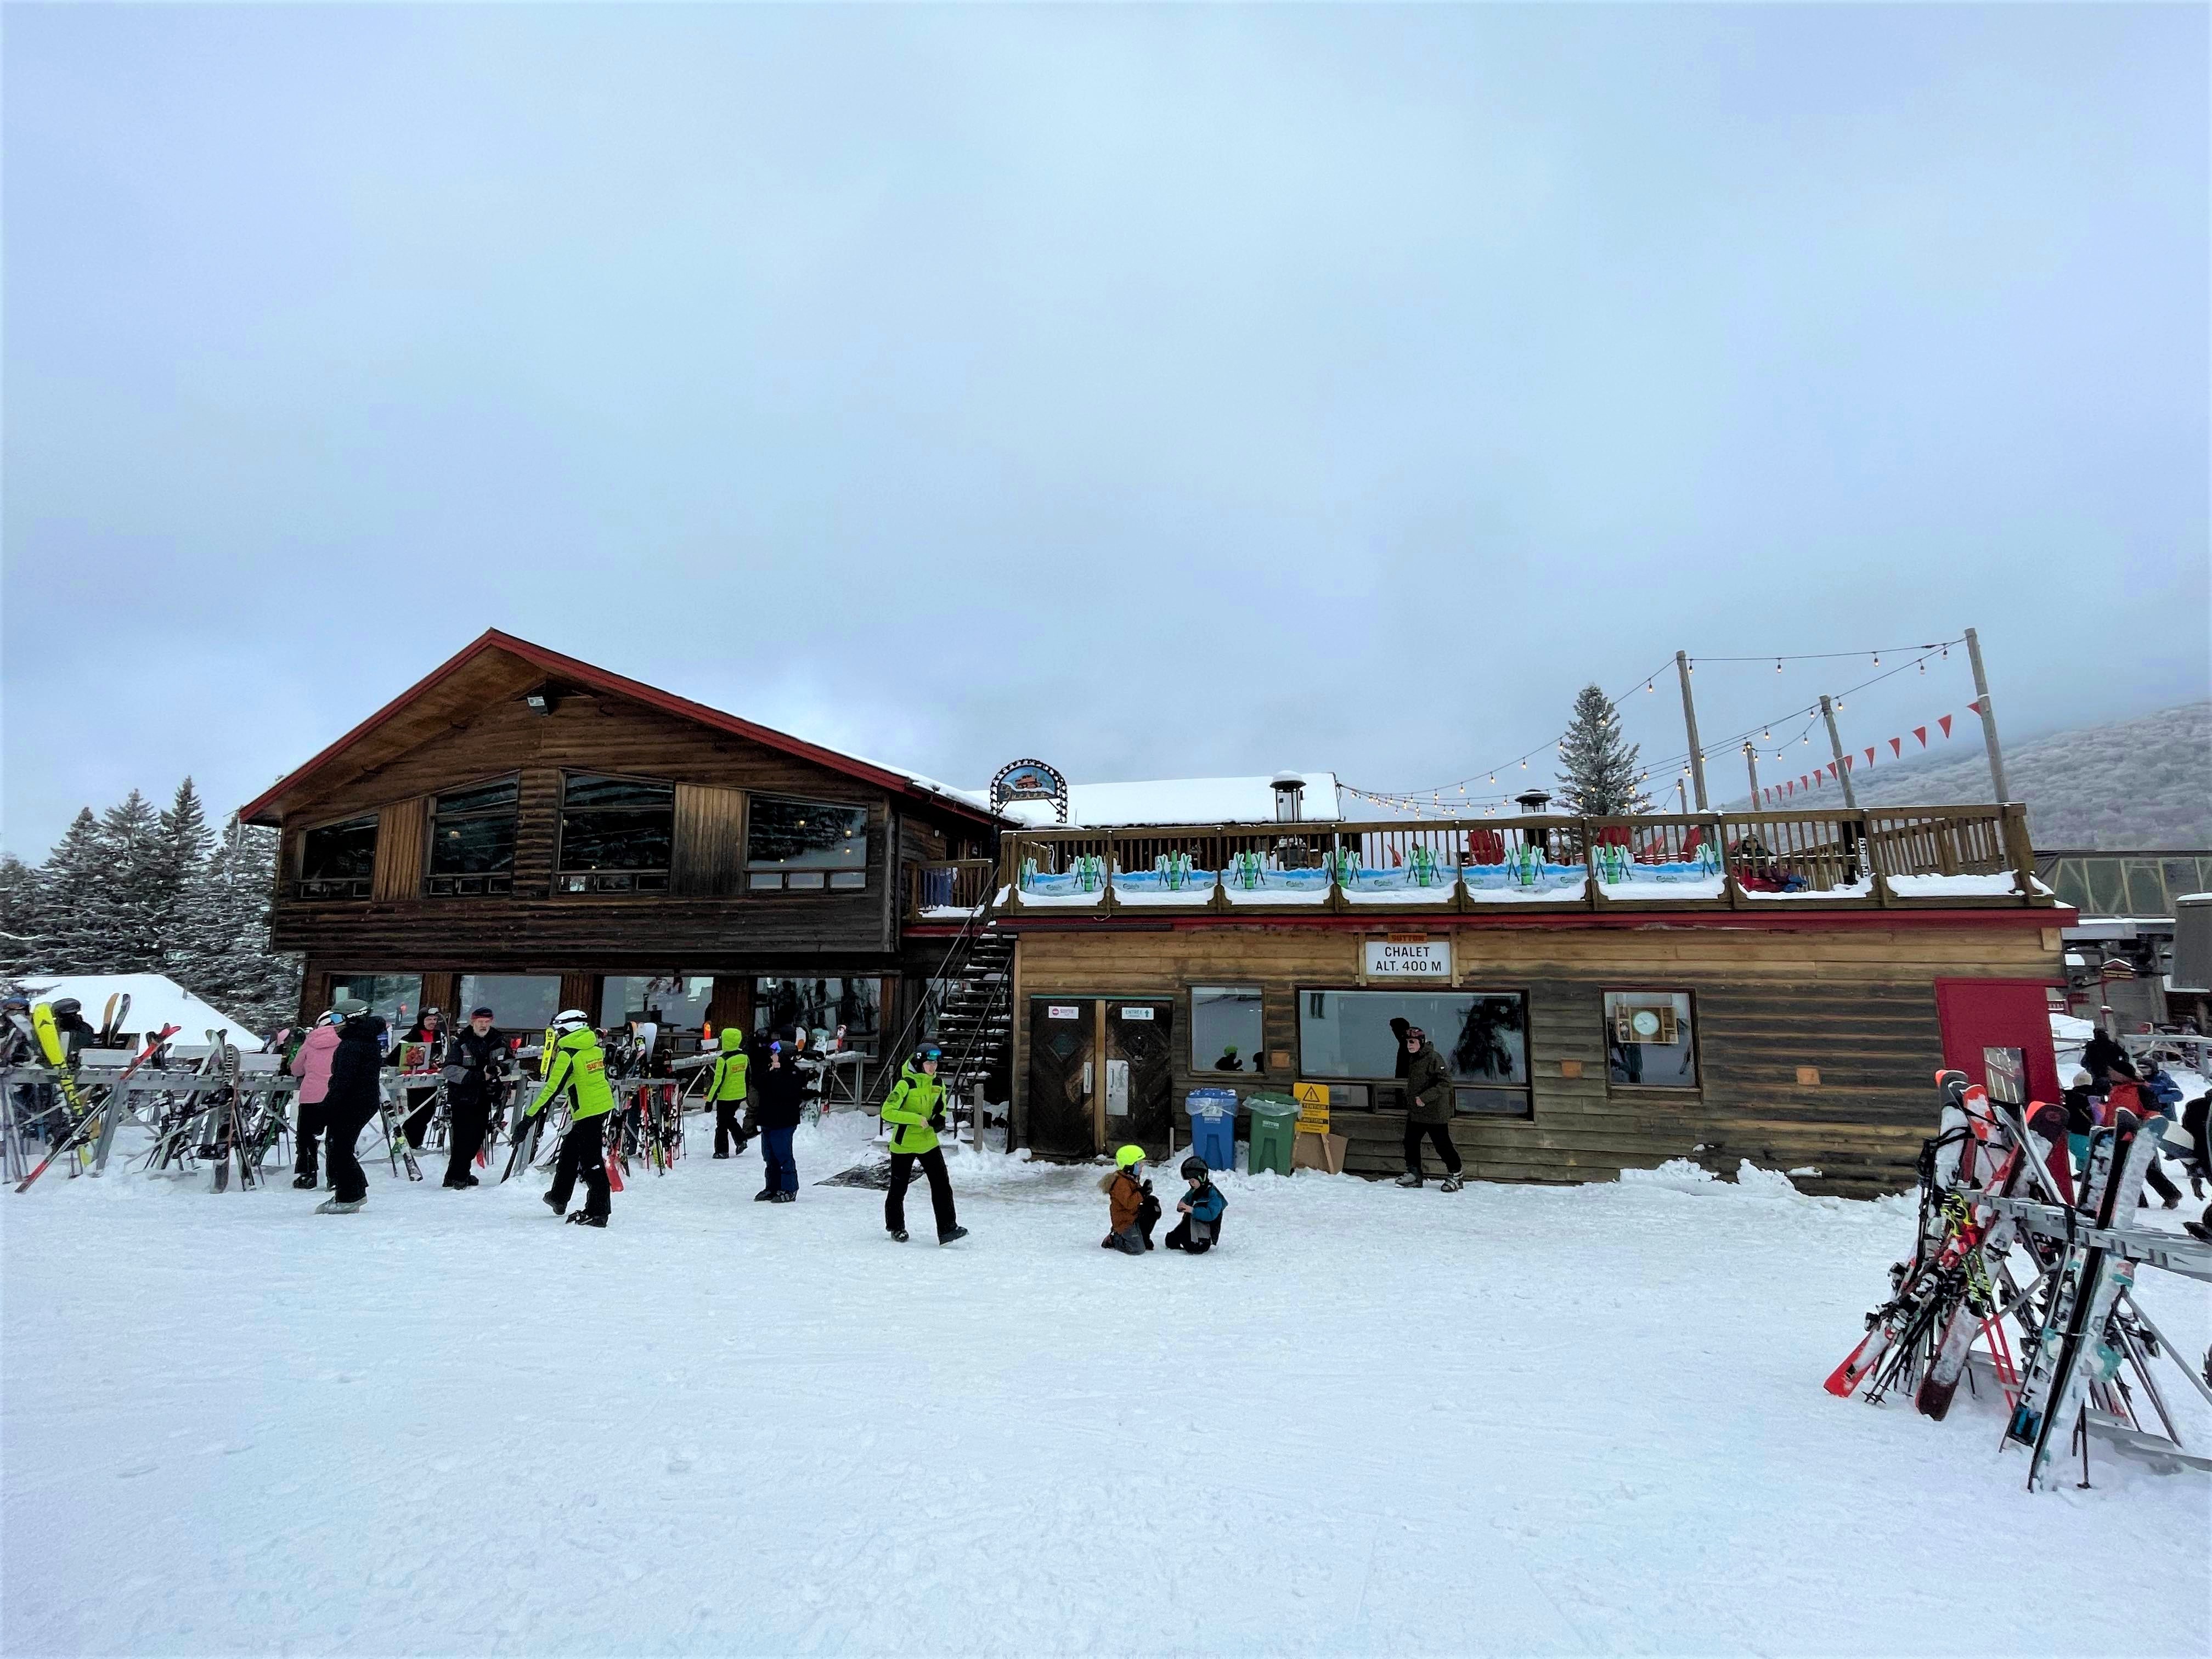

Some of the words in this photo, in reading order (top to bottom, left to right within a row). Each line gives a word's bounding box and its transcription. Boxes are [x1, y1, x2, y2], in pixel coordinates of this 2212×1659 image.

[1385, 947, 1430, 957] CHALET
[1376, 961, 1398, 971] ALT.
[1402, 961, 1426, 971] 400
[1431, 961, 1441, 971] M
